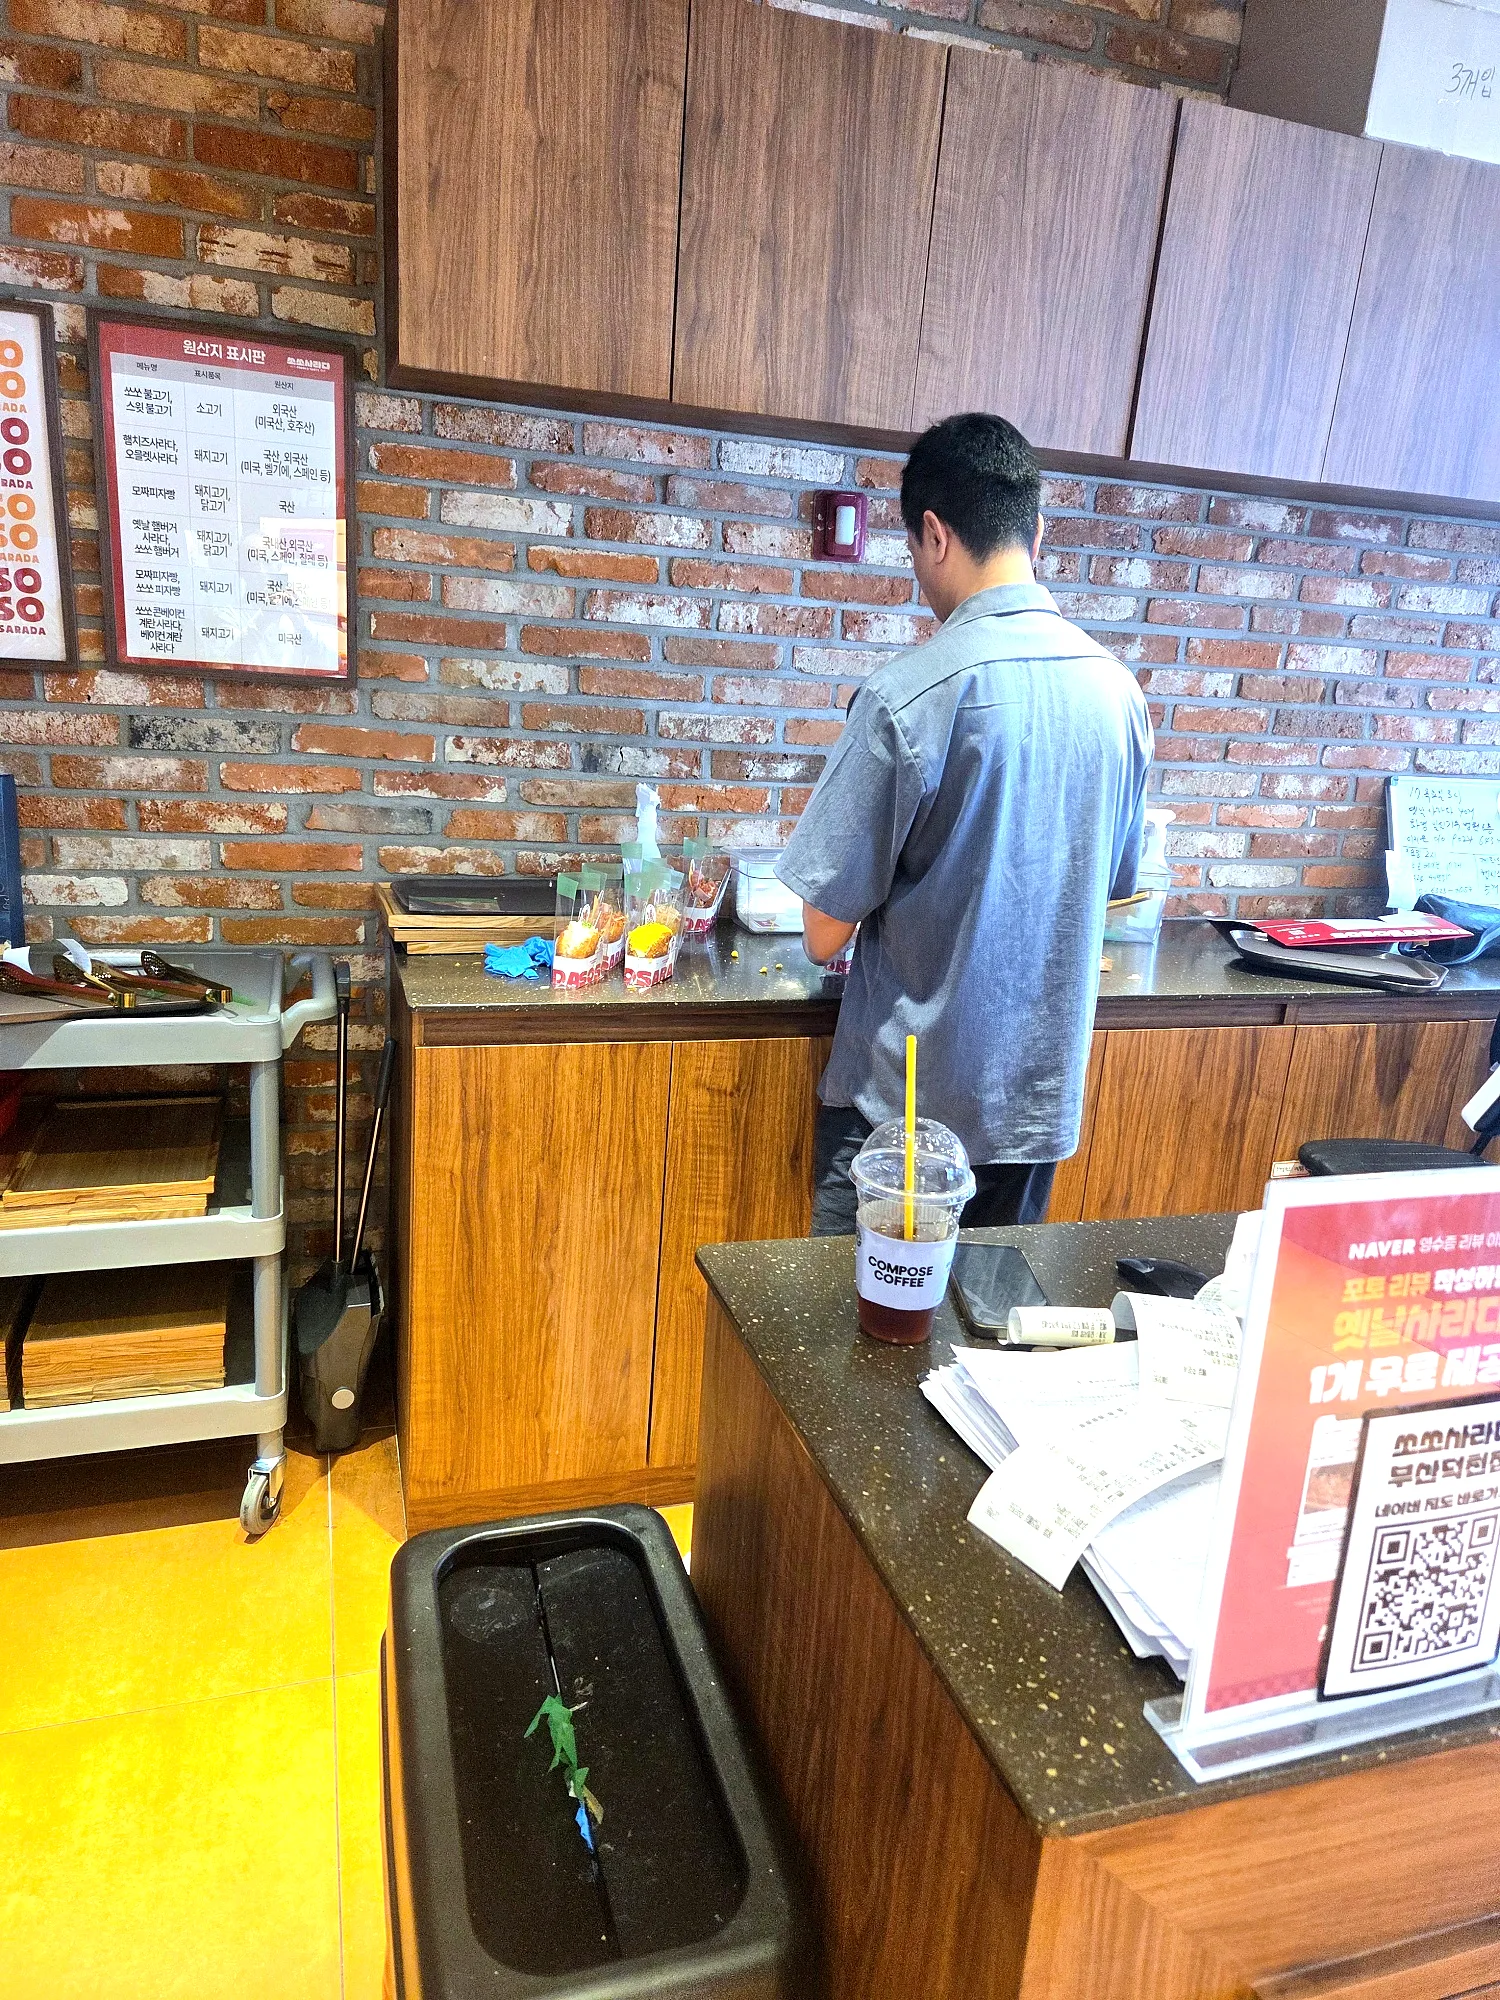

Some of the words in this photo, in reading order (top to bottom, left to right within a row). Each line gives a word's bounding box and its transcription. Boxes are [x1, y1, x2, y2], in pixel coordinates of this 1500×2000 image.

[183, 340, 223, 359] 원산지
[226, 345, 266, 365] 표시판
[136, 362, 158, 372] 메뉴명
[194, 370, 221, 381] 표시품목
[274, 380, 294, 391] 원산지
[124, 386, 143, 398] 쏘쏘
[143, 388, 173, 404] 불고기,
[0, 403, 27, 414] ADA
[126, 401, 144, 414] 스윗
[145, 403, 172, 417] 불고기
[196, 402, 222, 417] 소고기
[272, 403, 297, 419] 외국산
[255, 416, 285, 432] (미국산,
[287, 419, 315, 436] 호주산)
[123, 434, 178, 453] 햄치즈사라다,
[125, 449, 178, 465] 오믈렛사라다
[194, 449, 228, 465] 돼지고기
[263, 449, 282, 465] 국산,
[284, 452, 308, 467] 외국산
[240, 460, 263, 476] (미국,
[264, 463, 292, 480] 벨기에,
[293, 466, 318, 481] 스페인
[319, 469, 331, 484] 등)
[194, 484, 231, 502] 돼지고기,
[200, 498, 226, 514] 닭고기
[279, 500, 295, 514] 국산
[132, 519, 150, 531] 옛날
[151, 520, 178, 534] 햄버거
[142, 532, 171, 547] 사라다,
[196, 530, 233, 547] 돼지고기,
[134, 544, 153, 555] 쏘쏘
[153, 545, 180, 558] 햄버거
[203, 543, 228, 558] 닭고기
[247, 548, 269, 563] (미국,
[135, 569, 180, 585] 모짜피자빵,
[136, 583, 154, 594] 쏘쏘
[155, 584, 181, 597] 피자빵
[199, 580, 233, 595] 돼지고기
[135, 606, 153, 616] 쏘쏘
[153, 606, 186, 620] 콘베이컨
[139, 618, 156, 629] 계란
[156, 619, 183, 633] 사라다,
[201, 626, 234, 641] 돼지고기
[140, 630, 166, 641] 베이컨
[166, 632, 182, 643] 계란
[278, 632, 302, 646] 미국산
[150, 642, 175, 654] 사라다
[1348, 1238, 1416, 1260] NAVER
[1459, 1233, 1485, 1250] 리뷰
[1486, 1231, 1500, 1248] 이
[868, 1255, 934, 1277] COMPOSE
[873, 1270, 925, 1288] COFFEE
[1343, 1276, 1386, 1303] 포토
[1389, 1271, 1432, 1297] 리뷰
[1433, 1265, 1500, 1295] 작성하
[1309, 1359, 1364, 1404] 1개
[1364, 1351, 1440, 1398] 무료
[1374, 1499, 1422, 1518] 네이버
[1424, 1494, 1454, 1512] 지도
[1457, 1486, 1500, 1505] 바로가
